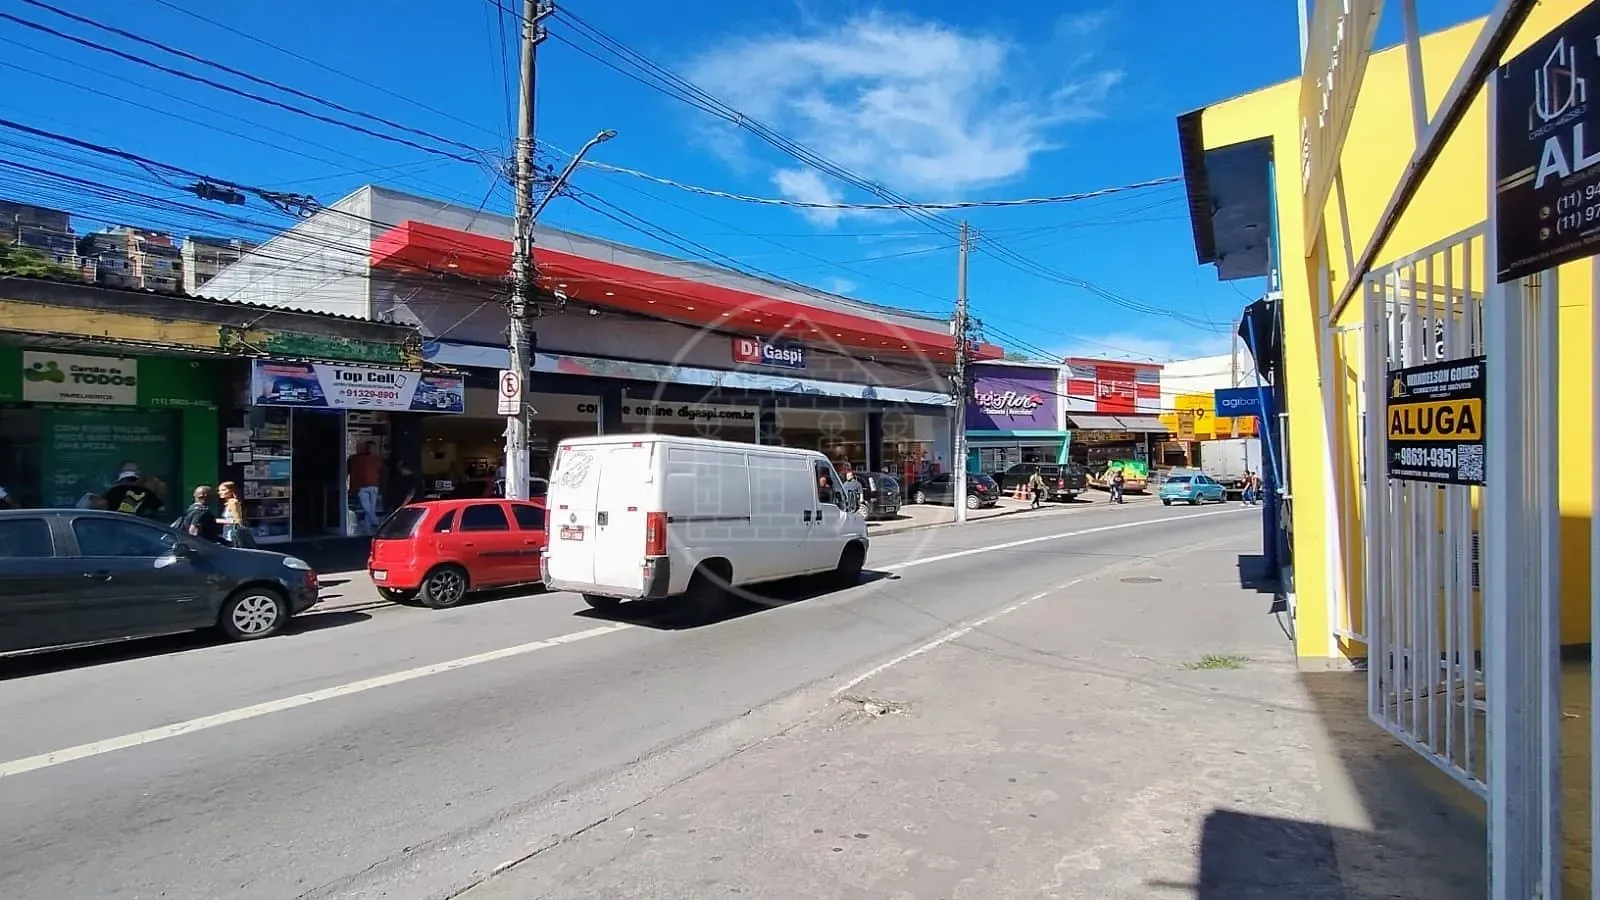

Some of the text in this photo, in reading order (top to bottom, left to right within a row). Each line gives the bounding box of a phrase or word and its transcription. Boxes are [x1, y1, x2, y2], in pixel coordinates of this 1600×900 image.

[1557, 190, 1582, 214] (11)
[1556, 211, 1582, 235] (11)
[741, 341, 802, 365] Di Gaspi
[70, 373, 136, 386] TODOS
[334, 370, 394, 383] Top Cell
[1450, 365, 1480, 381] GOMES
[346, 389, 399, 399] 91329-8901
[1222, 397, 1260, 408] agiban
[677, 405, 755, 420] digaspi.com.br
[1391, 404, 1477, 435] ALUGA
[1400, 447, 1457, 468] 98631-9351
